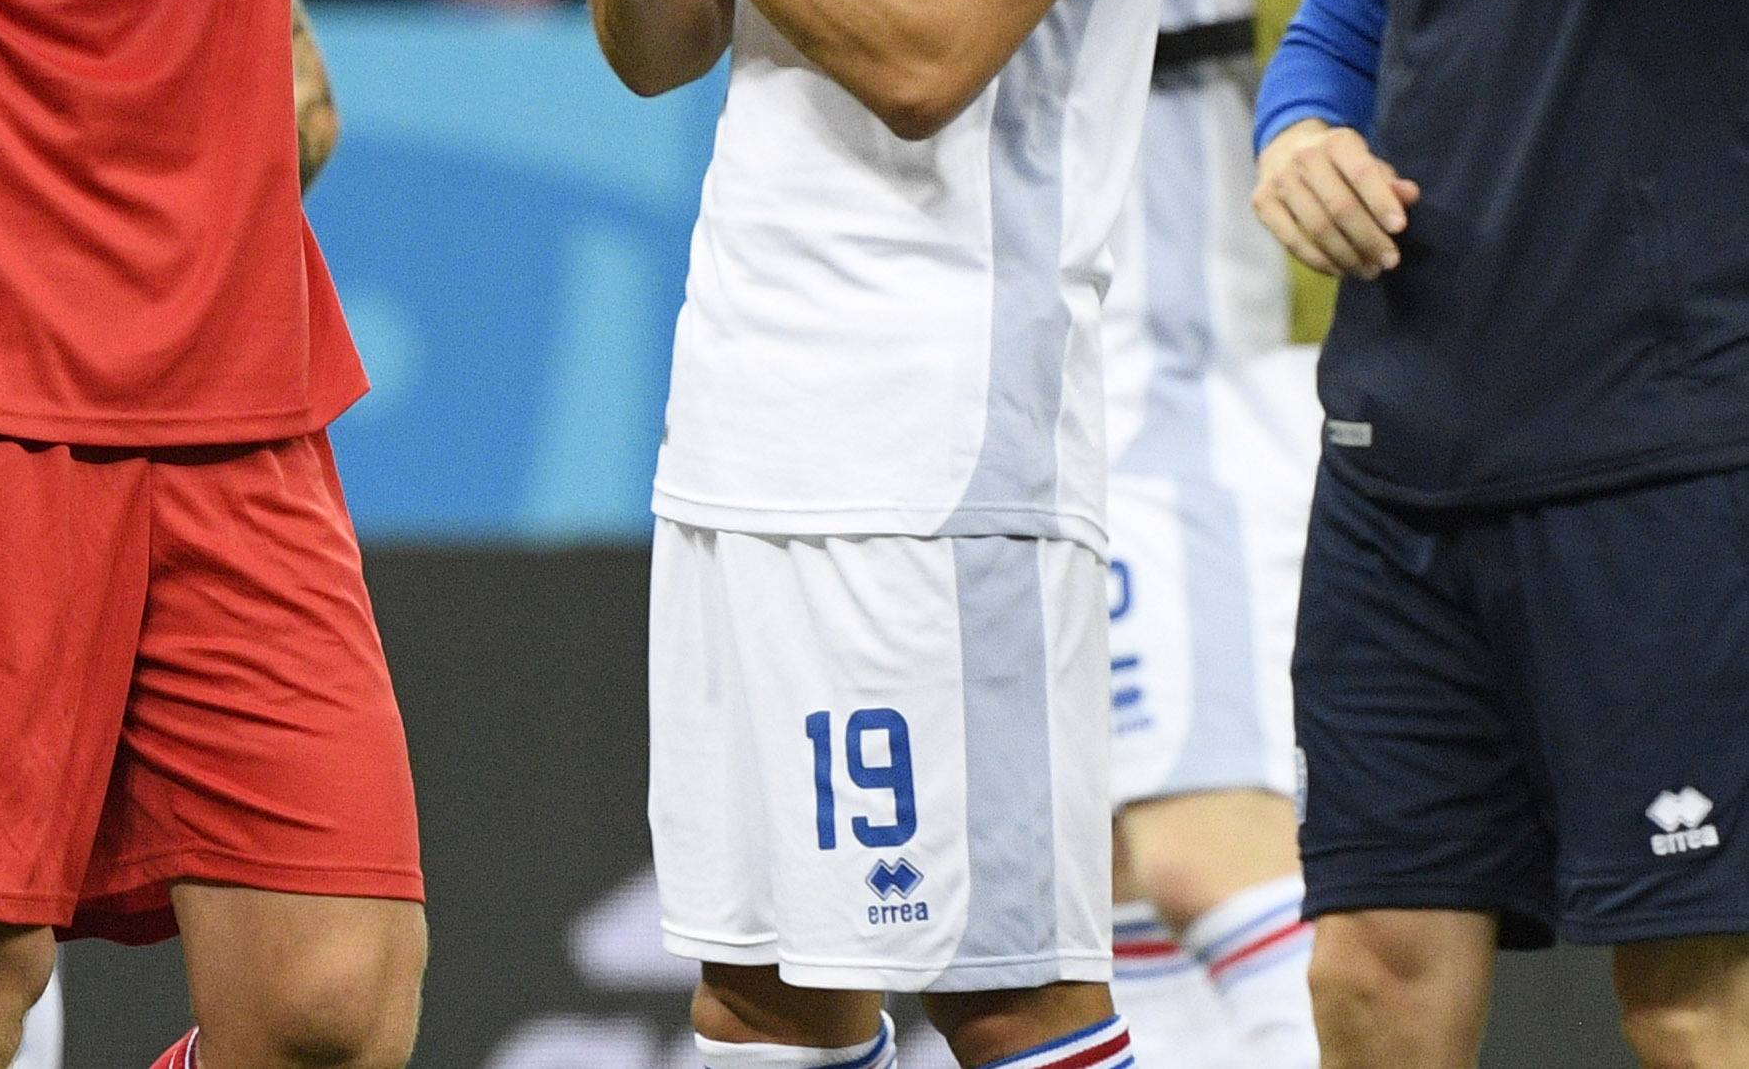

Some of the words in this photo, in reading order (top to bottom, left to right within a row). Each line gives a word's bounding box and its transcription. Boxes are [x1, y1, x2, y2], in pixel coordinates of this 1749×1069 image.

[805, 708, 918, 850] 19
[1650, 824, 1720, 856] errea
[867, 901, 930, 925] errea
